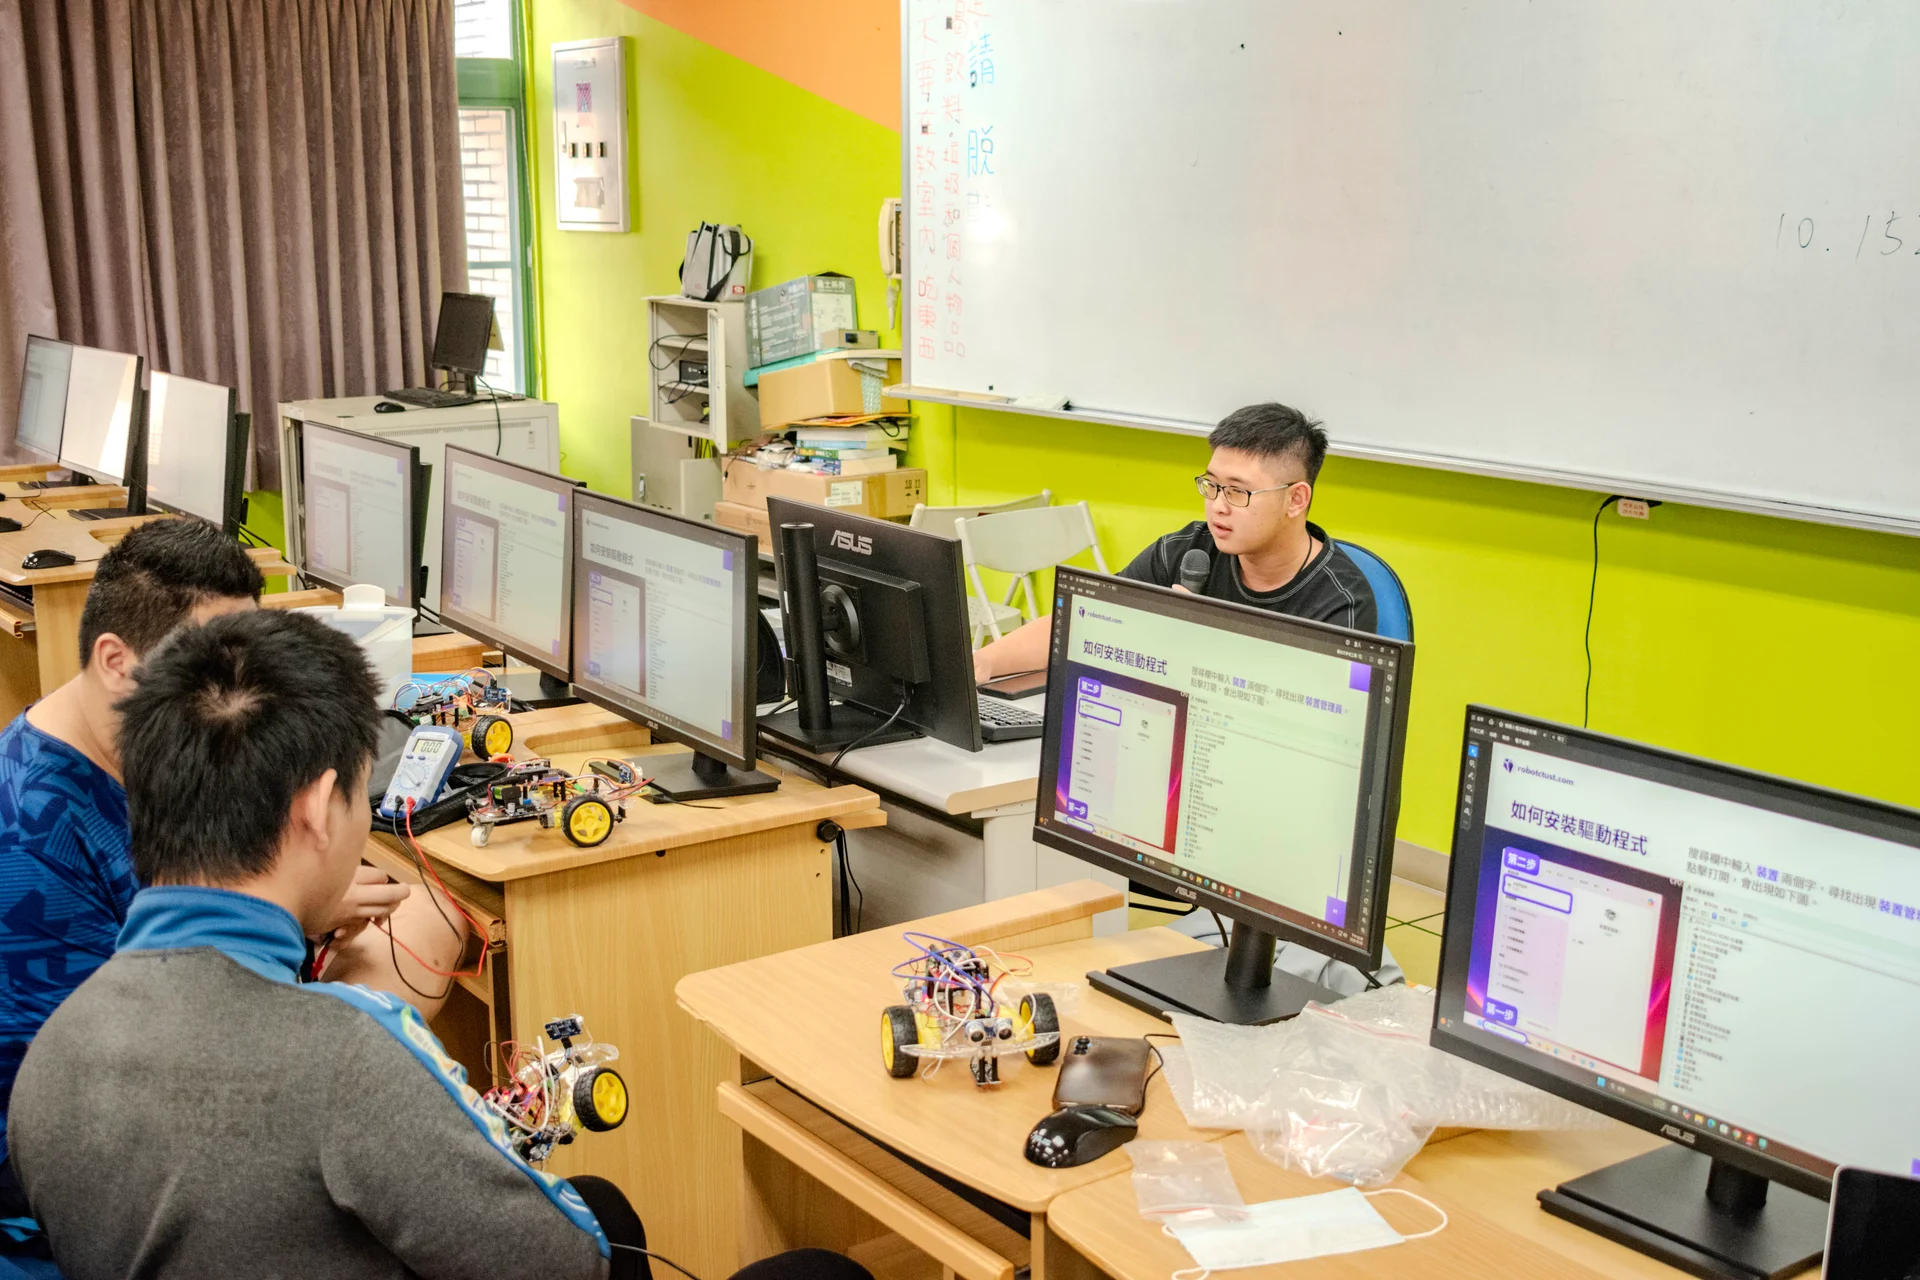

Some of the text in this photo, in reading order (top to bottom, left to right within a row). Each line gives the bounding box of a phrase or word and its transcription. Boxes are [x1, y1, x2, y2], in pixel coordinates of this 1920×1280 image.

[830, 529, 873, 556] ASUS
[1083, 639, 1168, 676] 如何安裝驅動程式
[1517, 764, 1574, 786] robotctust.com
[1510, 800, 1648, 856] 如何安裝驅動程式
[1507, 852, 1537, 870] 第二步
[1174, 885, 1197, 900] ASUS
[1756, 865, 1779, 883] 裝置
[1878, 898, 1920, 922] 裝置管
[1486, 1002, 1514, 1021] 第一步
[1660, 1124, 1696, 1144] ASUS
